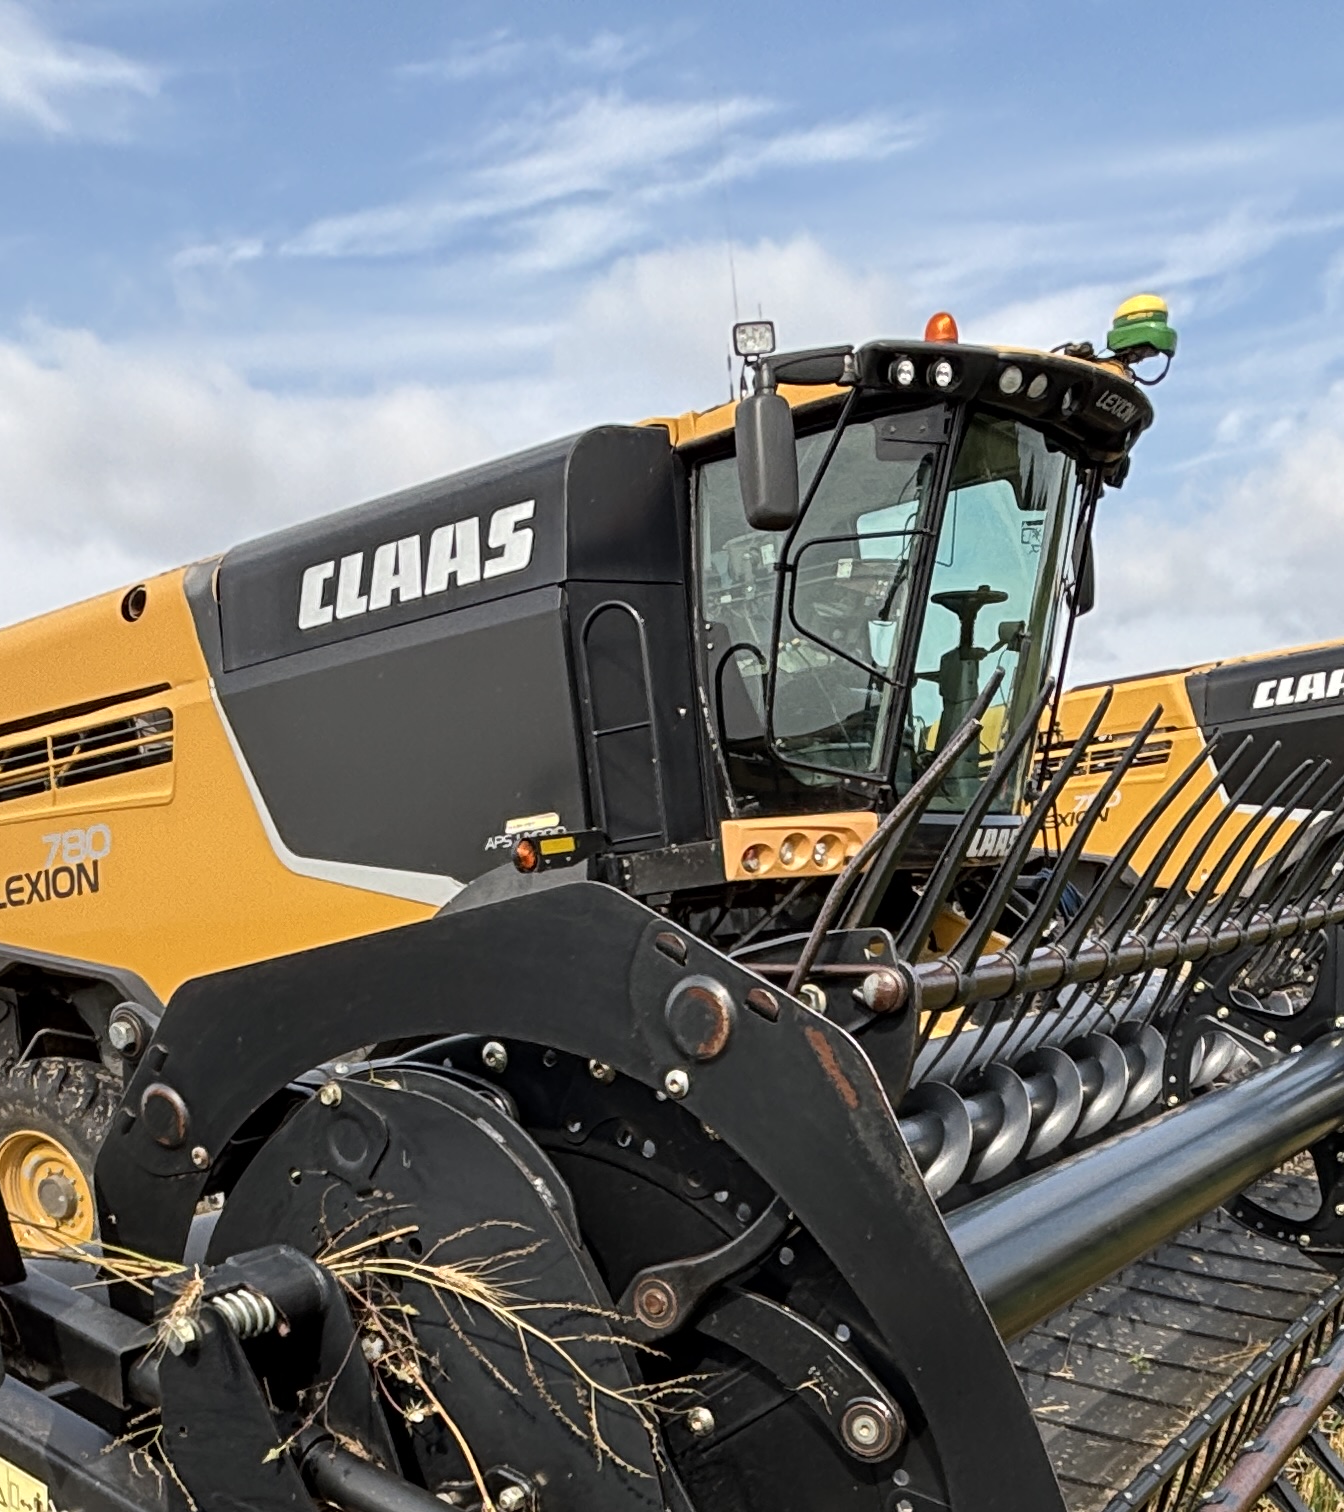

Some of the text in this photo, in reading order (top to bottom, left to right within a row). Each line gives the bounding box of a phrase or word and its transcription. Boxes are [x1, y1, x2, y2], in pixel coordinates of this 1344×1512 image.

[1096, 390, 1137, 423] LEXION
[298, 499, 535, 630] CLAAS
[41, 823, 112, 869] 780
[484, 833, 514, 851] APS
